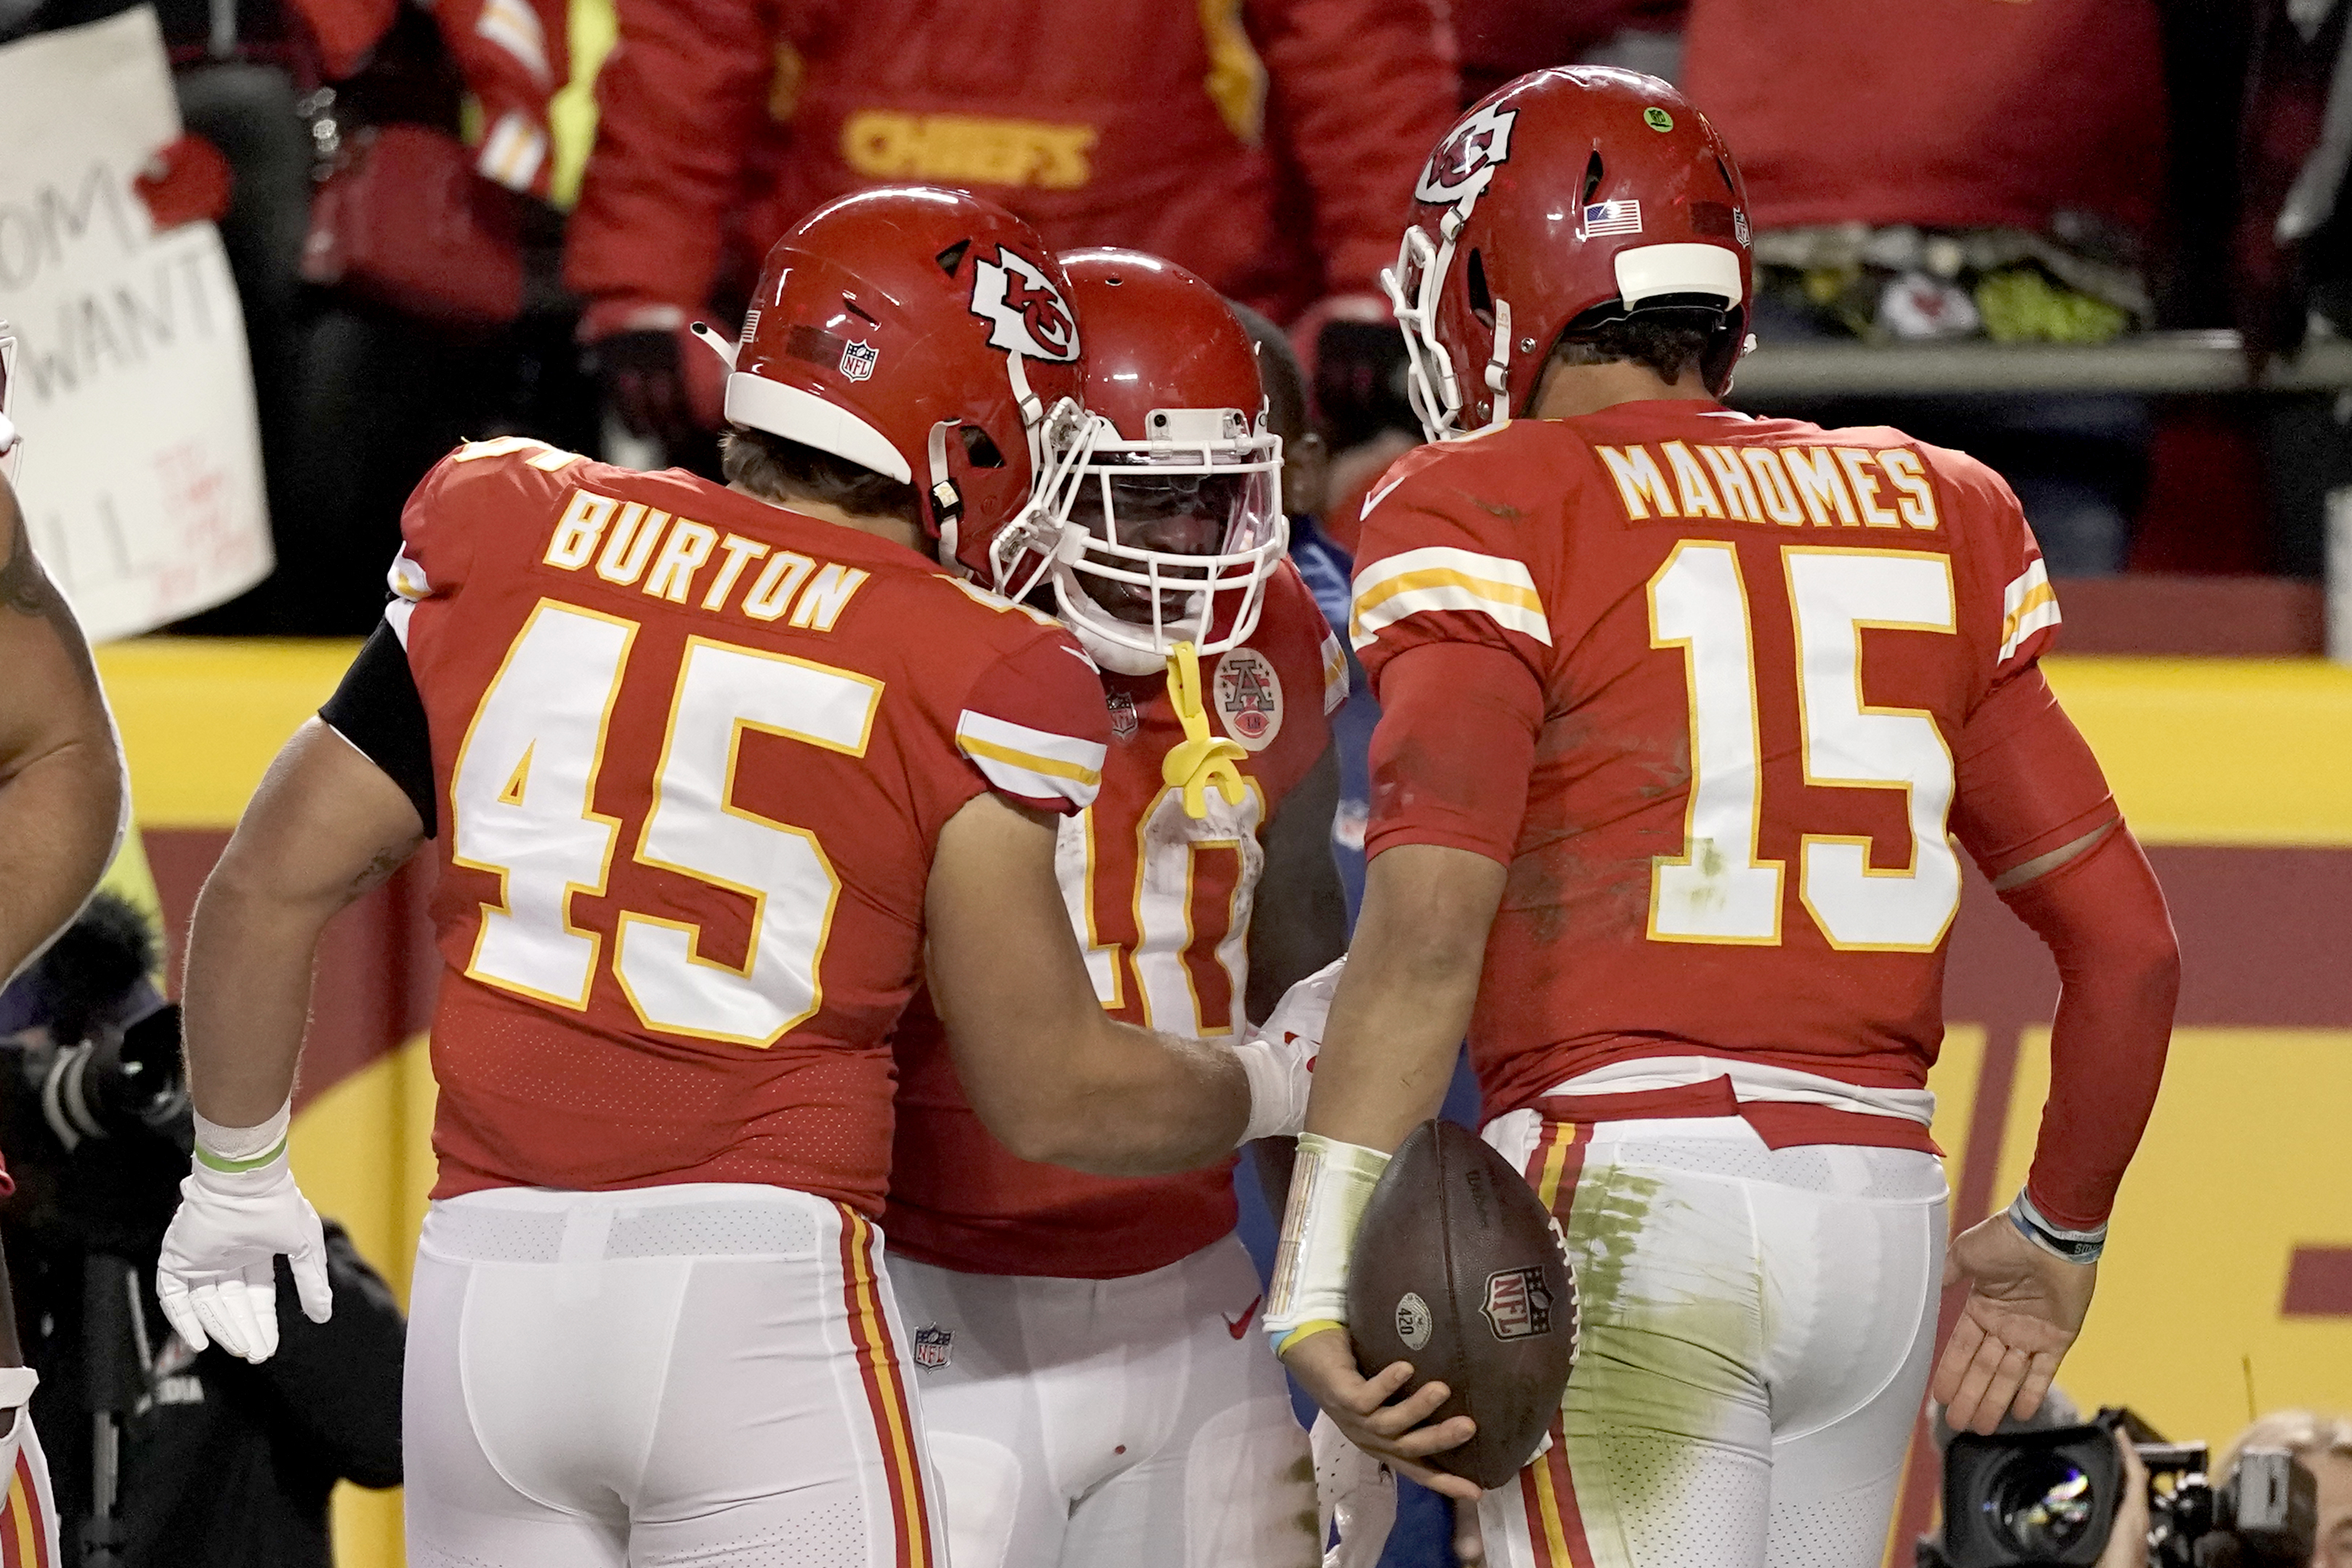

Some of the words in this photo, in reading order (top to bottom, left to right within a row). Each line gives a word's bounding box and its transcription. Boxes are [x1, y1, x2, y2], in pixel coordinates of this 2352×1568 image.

[13, 251, 218, 405] WANT
[844, 355, 868, 375] NFL
[1595, 440, 1939, 530] MAHOMES
[543, 488, 870, 633] BURTON
[1646, 539, 1963, 953] 15
[450, 597, 885, 1049] 45
[1398, 1308, 1414, 1335] 420
[1492, 1274, 1529, 1335] NFL
[918, 1344, 945, 1364] NFL
